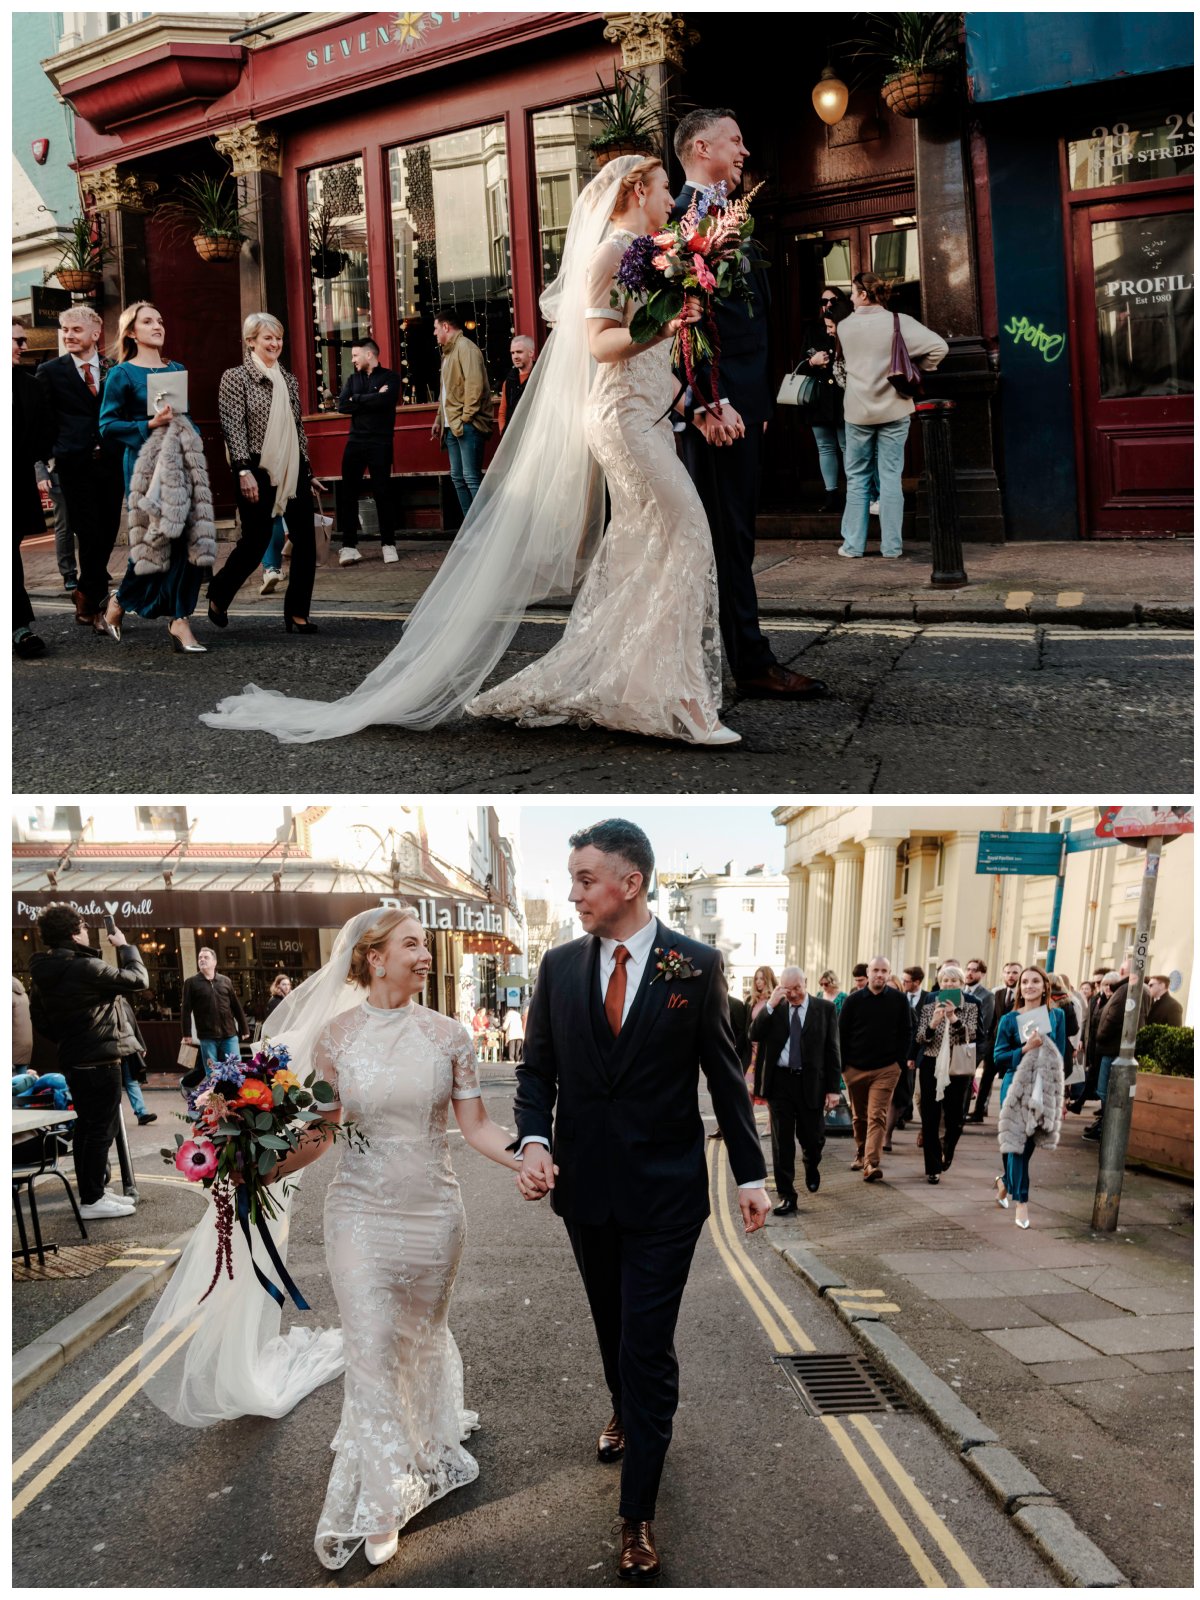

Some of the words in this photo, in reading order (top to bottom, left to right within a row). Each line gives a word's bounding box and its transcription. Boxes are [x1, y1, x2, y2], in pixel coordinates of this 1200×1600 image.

[306, 24, 392, 70] SEVEN
[1106, 274, 1194, 297] PROFIL
[1135, 296, 1148, 305] Est
[1152, 294, 1172, 303] 1980
[17, 900, 43, 921] Piz
[121, 899, 153, 917] Grill
[380, 898, 453, 929] lla
[455, 902, 504, 933] Italia
